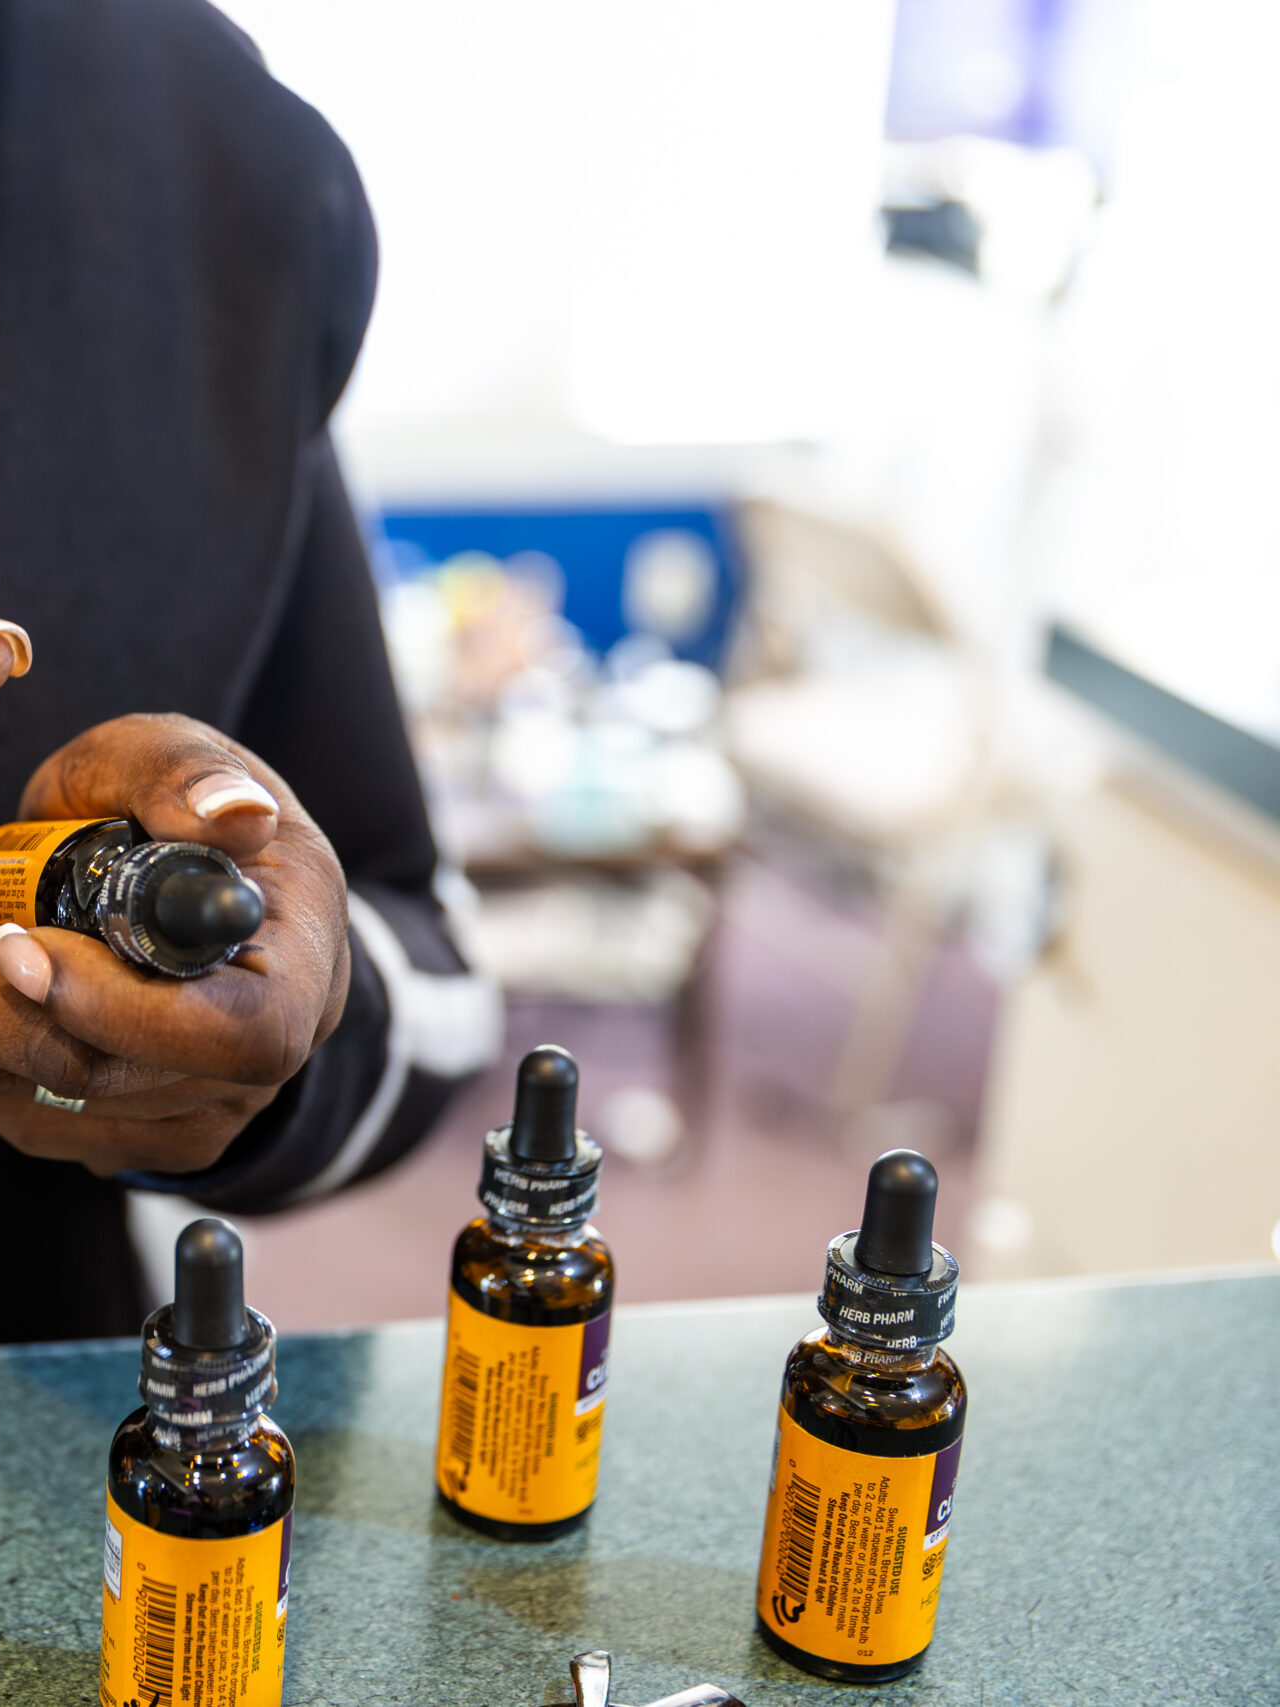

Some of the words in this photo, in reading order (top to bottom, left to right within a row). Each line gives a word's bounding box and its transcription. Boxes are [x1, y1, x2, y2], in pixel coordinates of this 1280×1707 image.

[827, 1267, 864, 1295] PHARM
[839, 1305, 871, 1324] HERB
[873, 1309, 915, 1325] PHARM
[853, 1482, 863, 1499] per
[867, 1482, 877, 1492] to
[878, 1476, 890, 1505] Adults:
[826, 1497, 837, 1519] Store
[838, 1491, 850, 1512] Keep
[849, 1500, 862, 1517] day.
[864, 1502, 873, 1513] oz.
[837, 1513, 848, 1527] Out
[862, 1516, 872, 1526] of
[875, 1506, 887, 1523] Add
[822, 1520, 832, 1540] away
[836, 1527, 846, 1537] of
[848, 1519, 860, 1539] Best
[834, 1537, 845, 1549] the
[859, 1527, 869, 1551] water
[822, 1540, 832, 1558] from
[845, 1541, 856, 1565] taken
[858, 1552, 866, 1562] or
[870, 1532, 881, 1567] squeeze
[892, 1526, 908, 1577] SUGGESTED
[137, 1562, 147, 1571] 0
[819, 1559, 829, 1577] heat
[831, 1551, 843, 1575] Reach
[830, 1576, 839, 1585] of
[854, 1562, 866, 1585] juice,
[868, 1568, 877, 1577] of
[815, 1585, 826, 1603] light
[840, 1567, 854, 1604] between
[866, 1578, 876, 1592] the
[889, 1578, 901, 1596] USE
[826, 1585, 838, 1616] Children
[852, 1596, 861, 1605] to
[861, 1593, 874, 1625] dropper
[848, 1615, 859, 1639] times
[859, 1626, 870, 1644] bulb
[857, 1649, 874, 1657] 012
